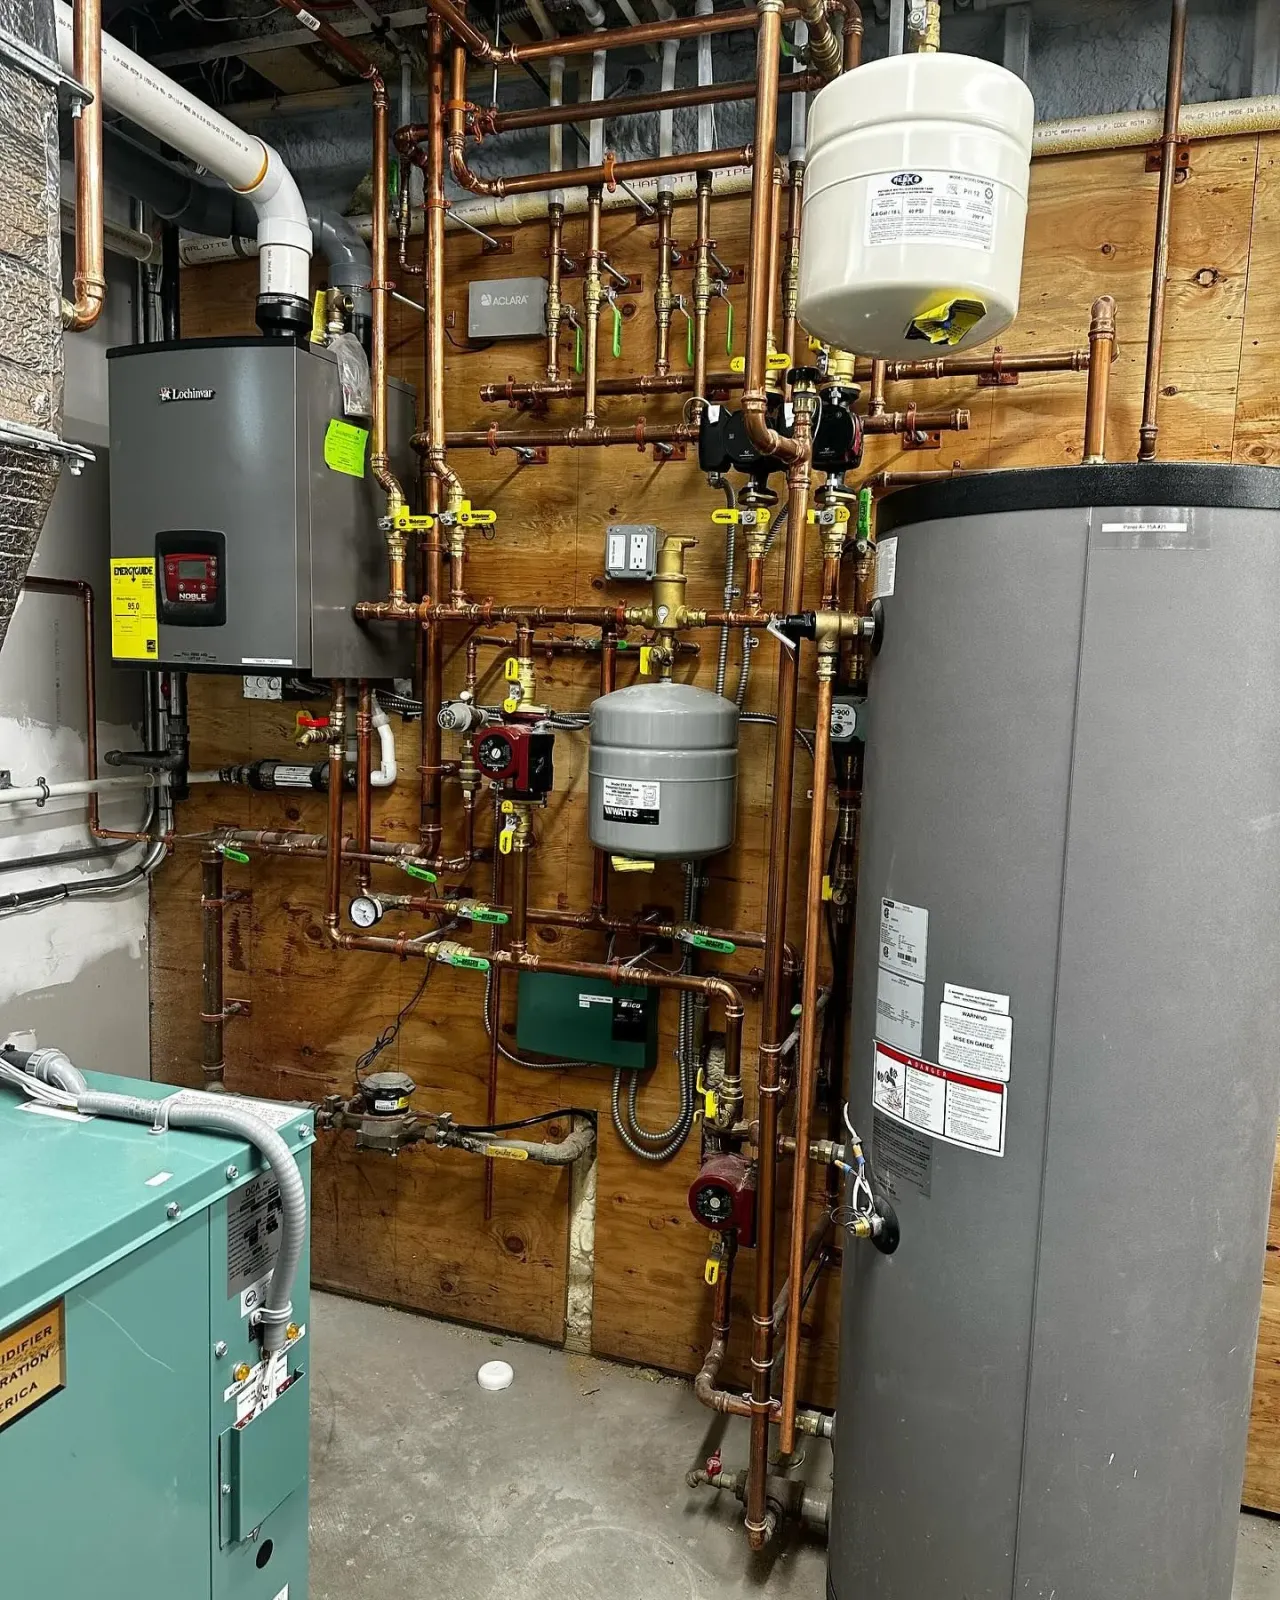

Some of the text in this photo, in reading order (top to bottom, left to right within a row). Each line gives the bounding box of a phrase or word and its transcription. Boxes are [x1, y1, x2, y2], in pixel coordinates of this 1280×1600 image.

[714, 167, 752, 178] PIPE
[492, 295, 528, 306] ACLARA
[172, 387, 213, 400] Lochinvar
[127, 602, 140, 610] 95.0
[612, 807, 639, 818] WATTS
[962, 1011, 988, 1022] WARNING
[953, 1035, 966, 1043] MISE
[974, 1041, 995, 1050] GARDE
[914, 1061, 947, 1078] DANGER
[0, 1350, 49, 1388] RATION
